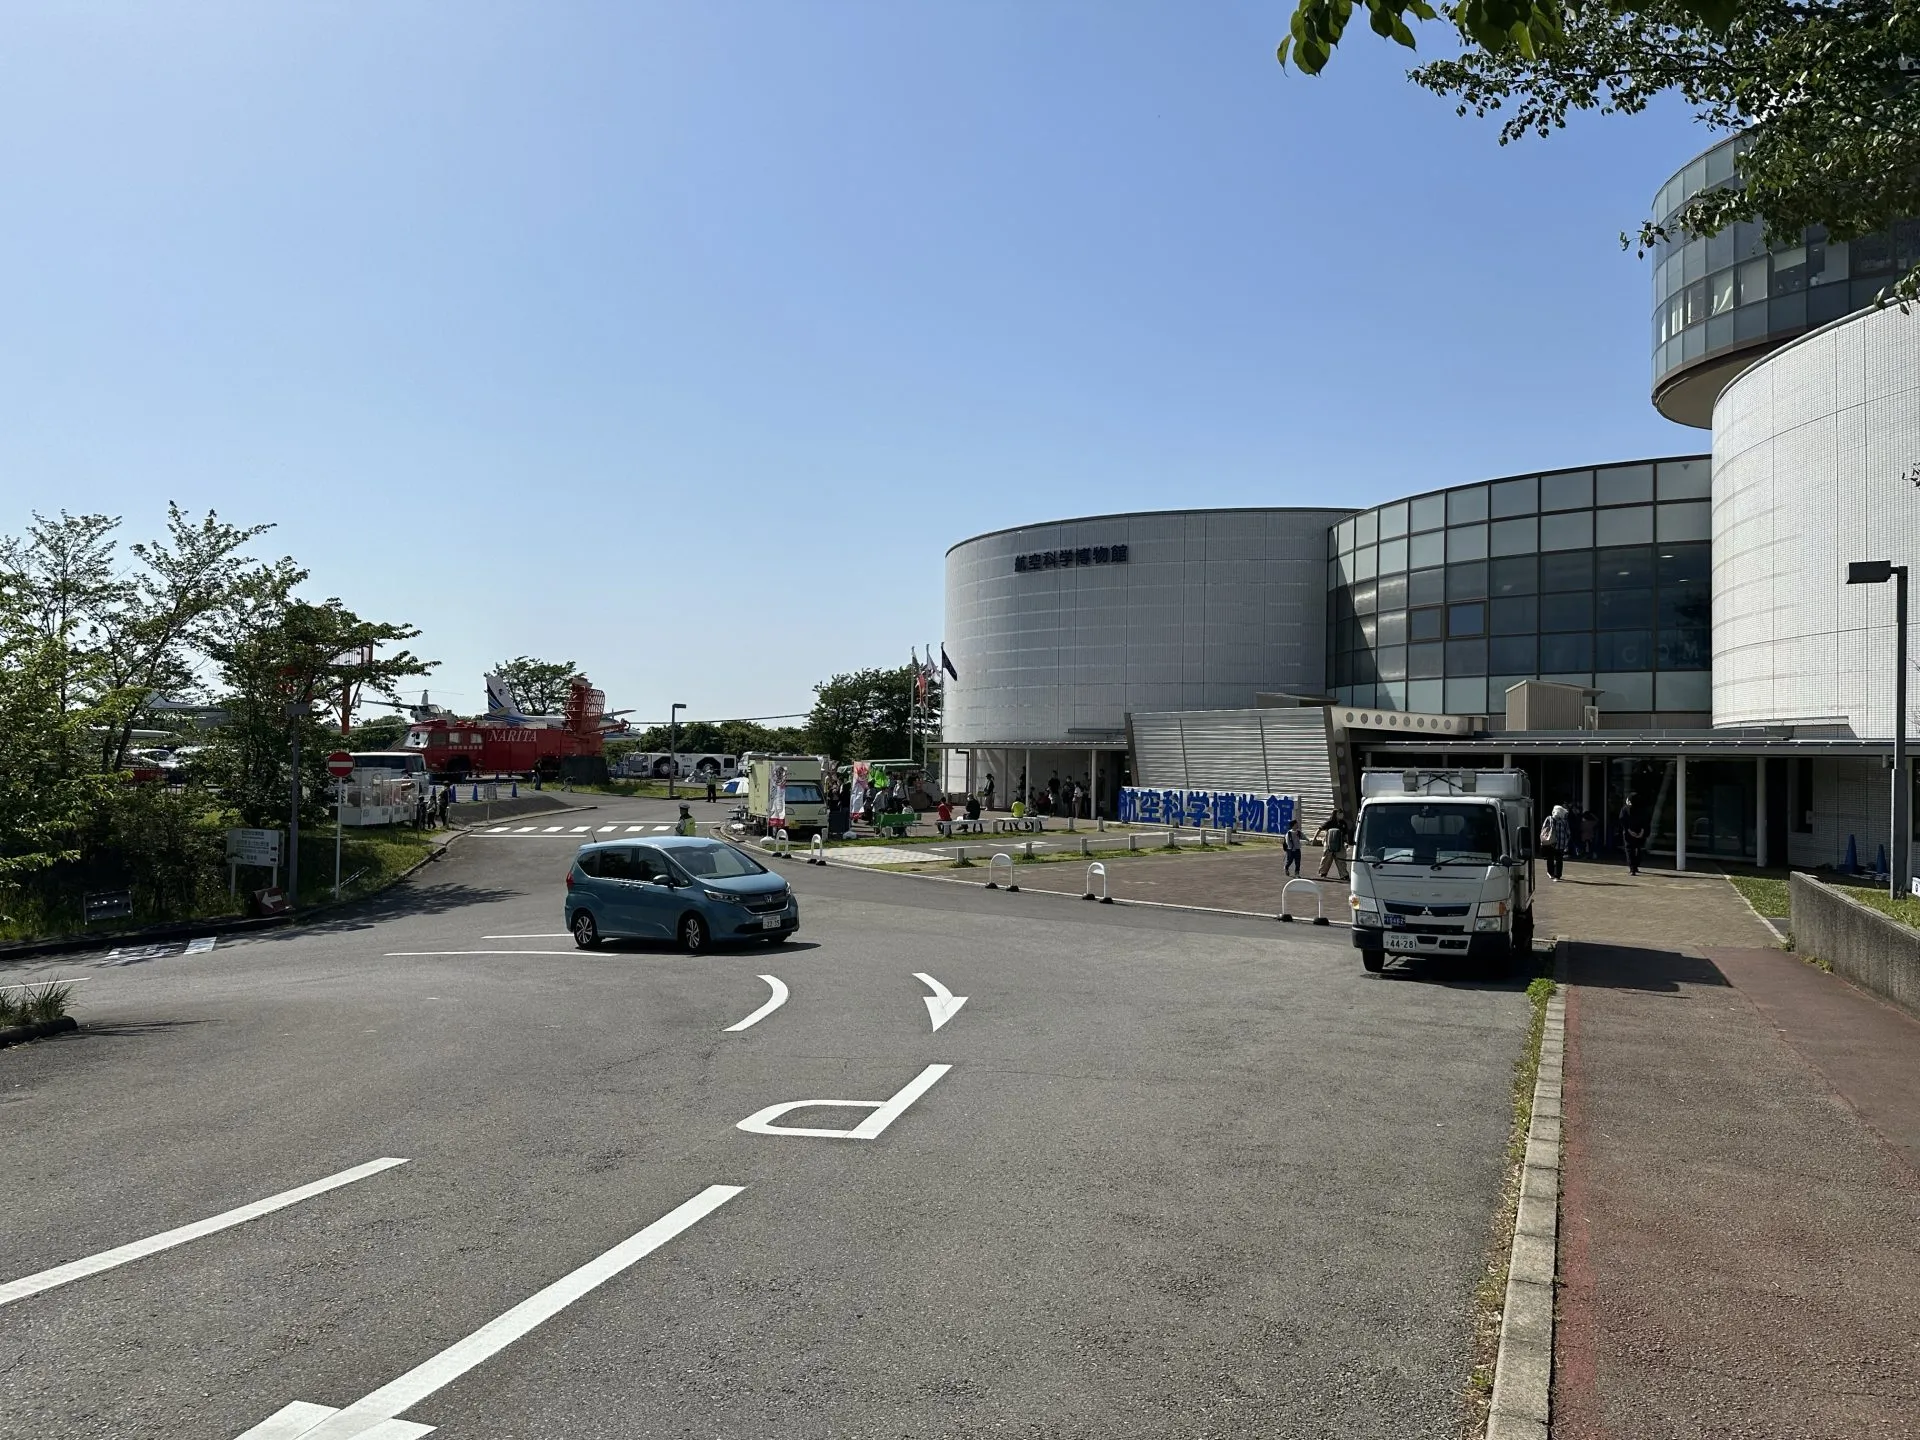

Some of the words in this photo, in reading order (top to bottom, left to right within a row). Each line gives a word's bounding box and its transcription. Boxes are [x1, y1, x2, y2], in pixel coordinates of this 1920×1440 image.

[1015, 544, 1128, 572] 航空科学博物館
[488, 730, 537, 742] NARITA
[1118, 787, 1294, 833] 航空科学博物館
[1390, 939, 1414, 949] 44-28
